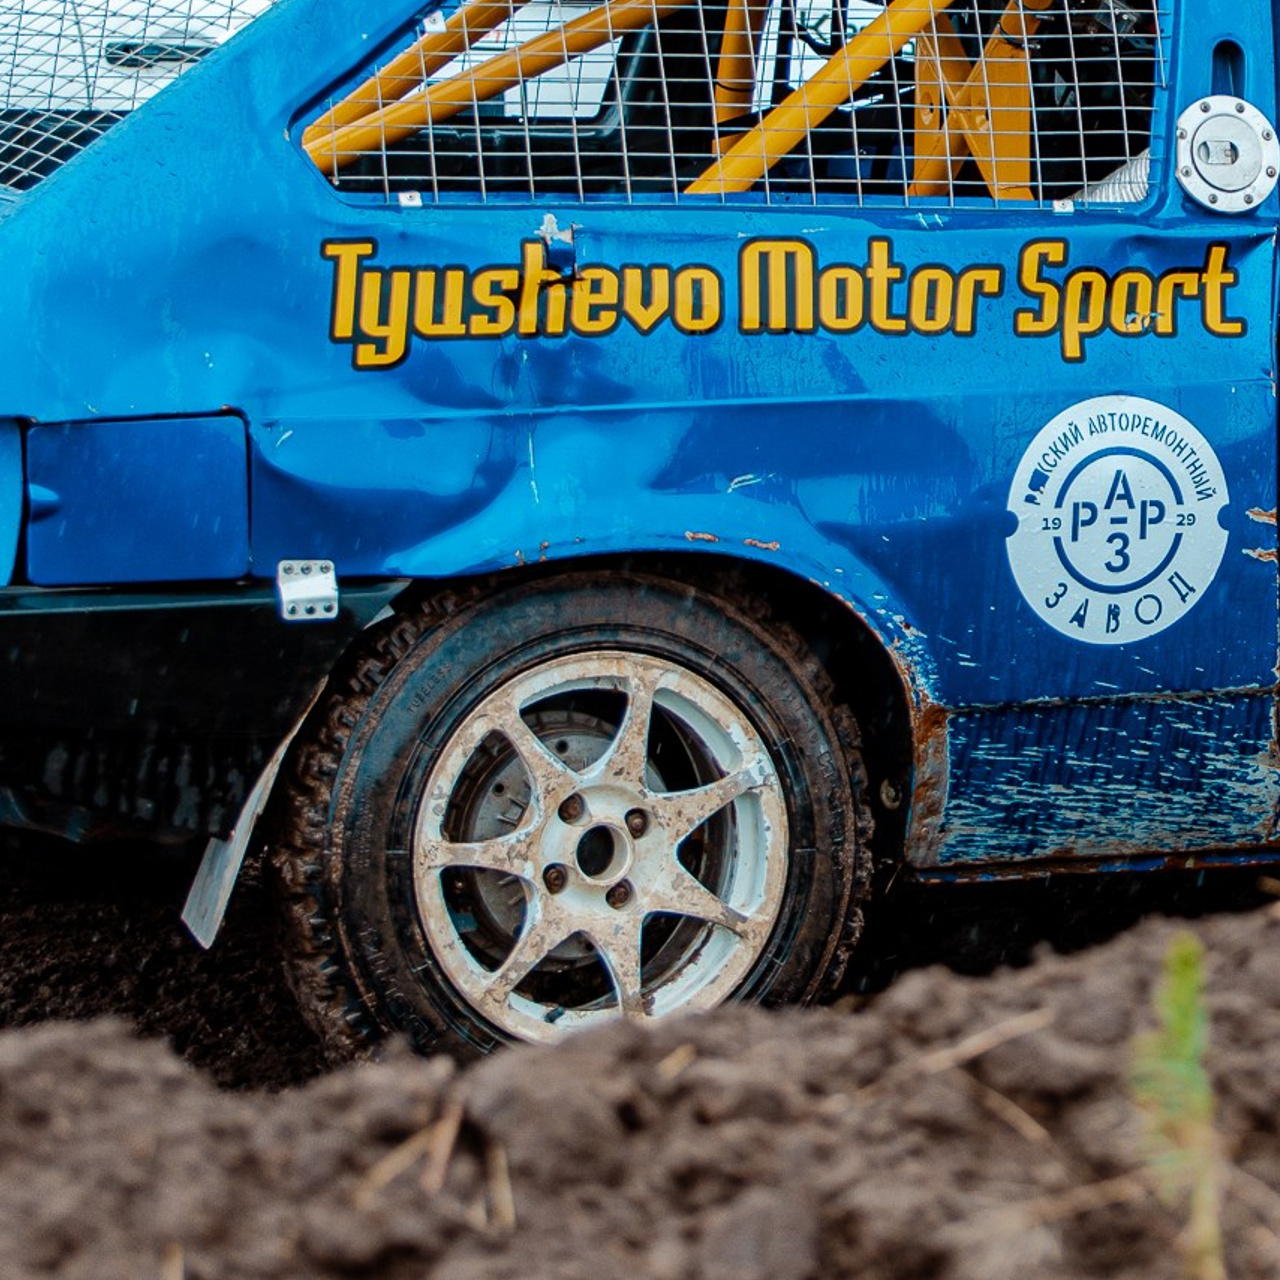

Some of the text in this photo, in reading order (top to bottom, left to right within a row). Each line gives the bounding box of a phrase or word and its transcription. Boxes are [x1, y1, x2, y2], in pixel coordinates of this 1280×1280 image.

[323, 238, 1244, 368] Tyushevo Motor Sport
[1042, 518, 1062, 531] 19
[1176, 513, 1196, 527] 29
[1045, 572, 1196, 634] ЗАВОД
